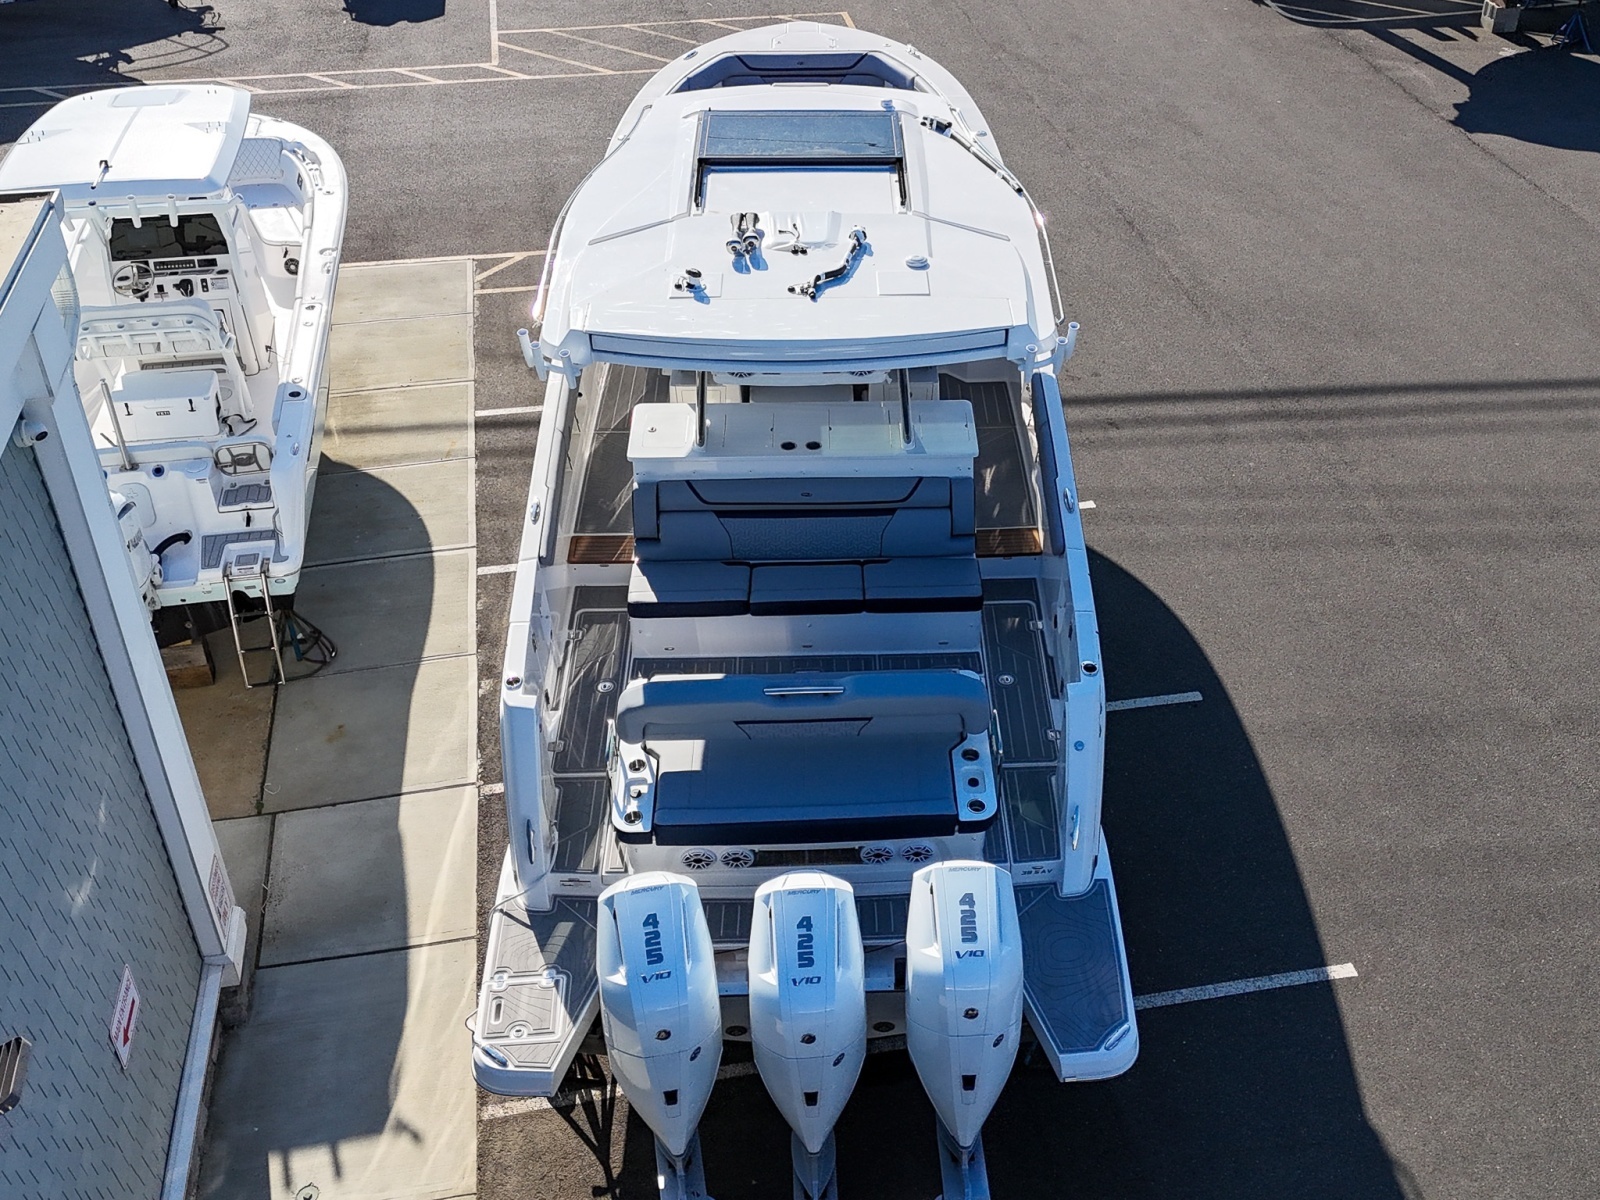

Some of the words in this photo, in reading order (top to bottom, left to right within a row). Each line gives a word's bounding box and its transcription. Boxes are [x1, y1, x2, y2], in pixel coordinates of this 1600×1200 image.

[630, 885, 665, 896] MERCURY
[959, 892, 978, 944] 425
[642, 912, 664, 966] 425
[796, 915, 815, 969] 425
[955, 949, 985, 960] V10
[641, 970, 672, 984] V10
[791, 976, 822, 987] V10
